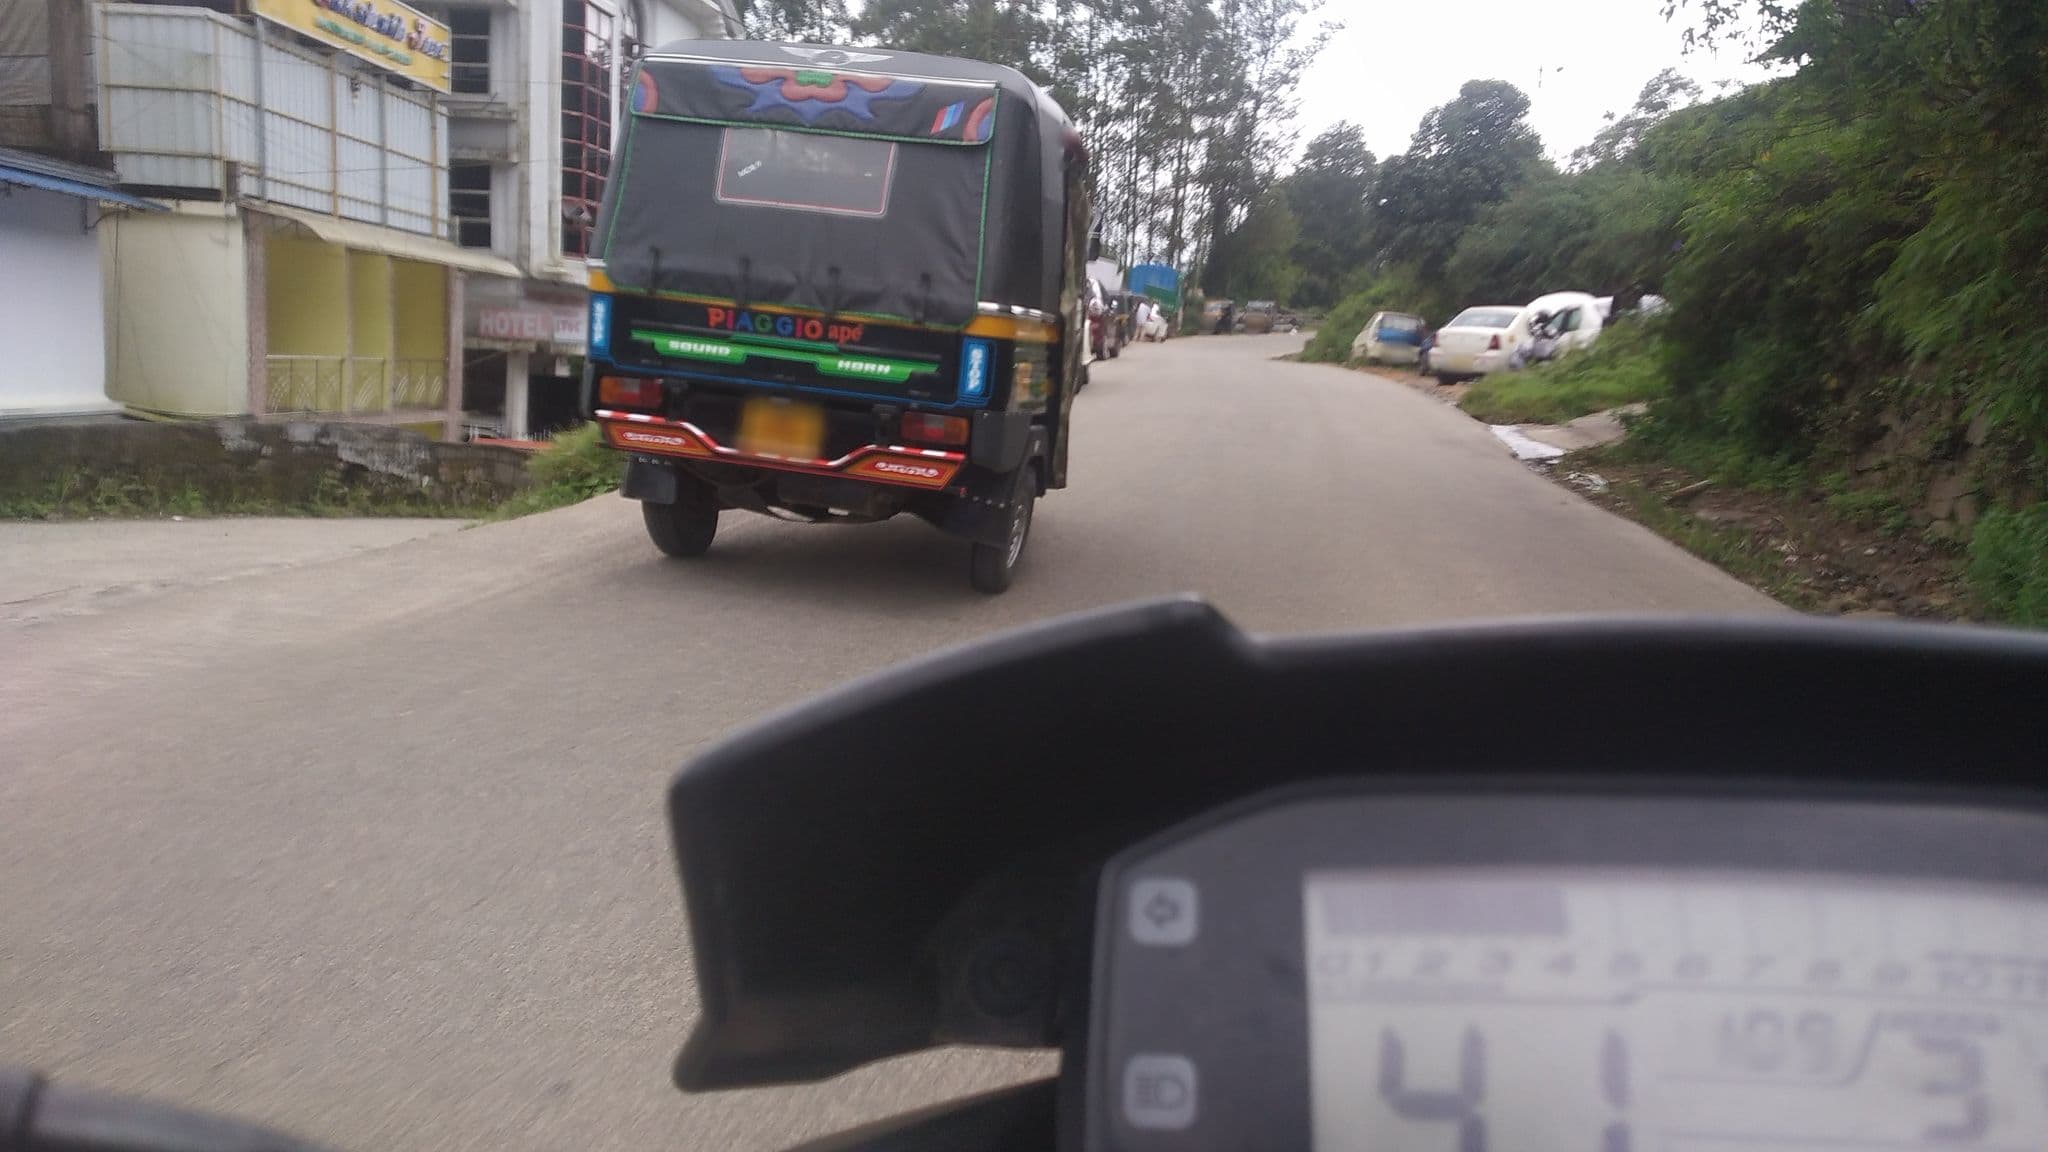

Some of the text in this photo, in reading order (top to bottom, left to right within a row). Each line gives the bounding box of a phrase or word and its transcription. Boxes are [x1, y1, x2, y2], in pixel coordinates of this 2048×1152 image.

[479, 308, 552, 338] HOTEL
[707, 307, 823, 340] PIAGGIO
[668, 341, 731, 355] SOUND
[837, 360, 891, 374] HORN
[1911, 1038, 1988, 1143] 3
